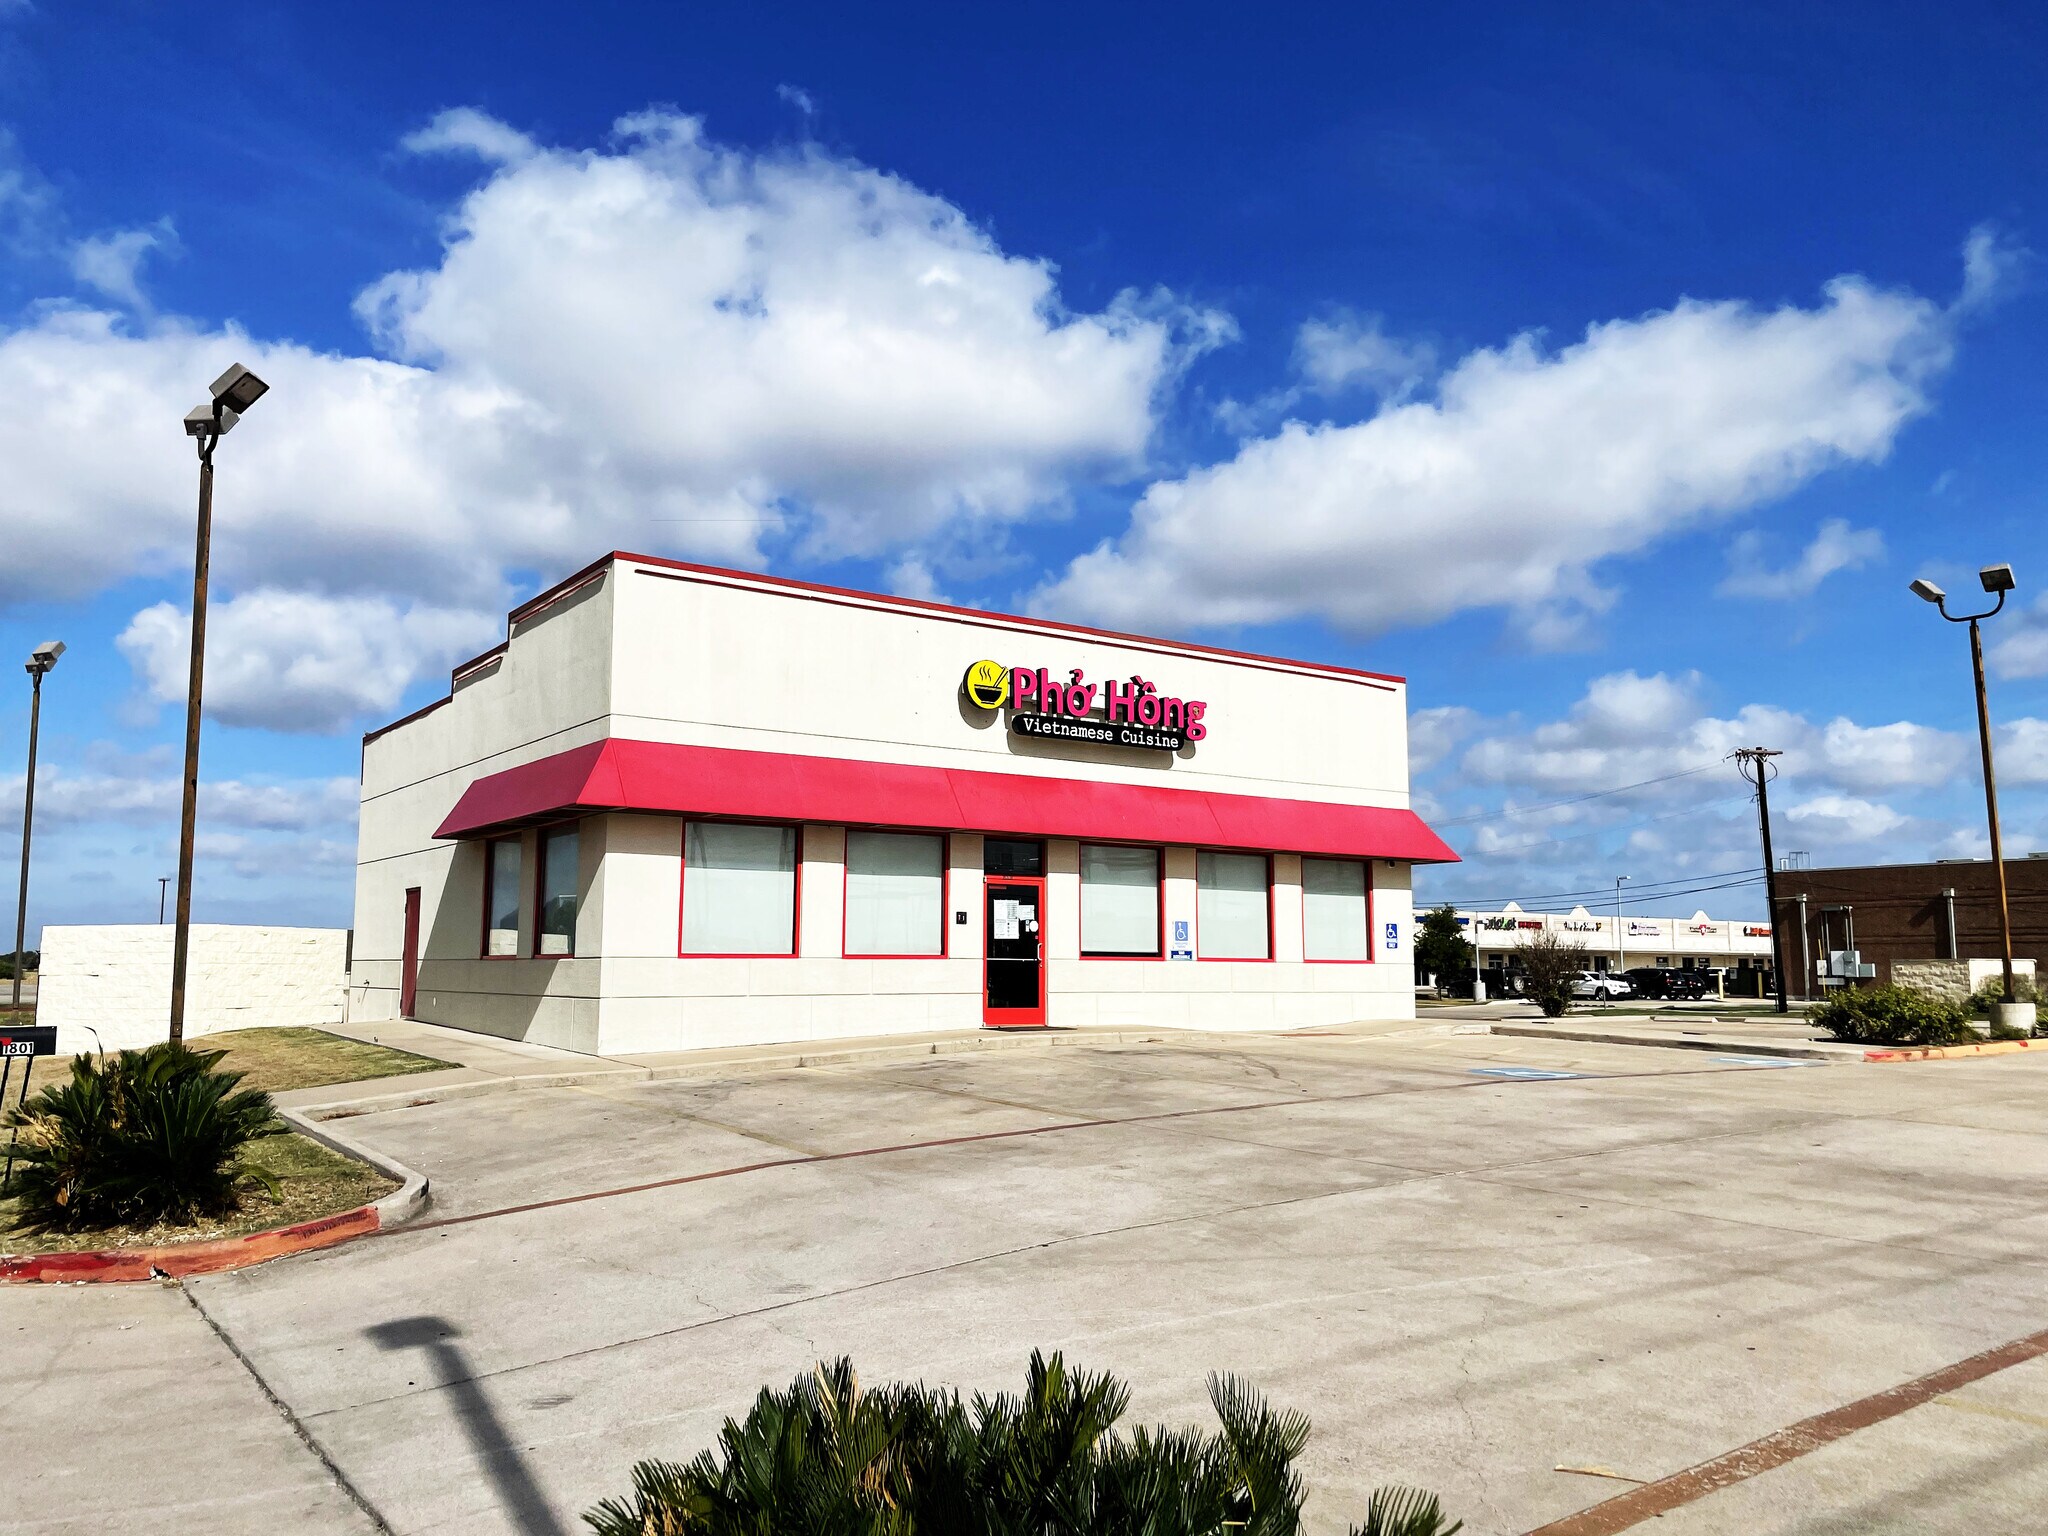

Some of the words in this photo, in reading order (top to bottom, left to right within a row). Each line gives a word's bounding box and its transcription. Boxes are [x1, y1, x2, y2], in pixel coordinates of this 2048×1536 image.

[1011, 667, 1097, 717] Phở
[1106, 675, 1206, 741] Hồng
[1023, 718, 1114, 741] Vietnamese
[1121, 730, 1179, 748] Cuisine
[4, 1043, 33, 1054] 1801
